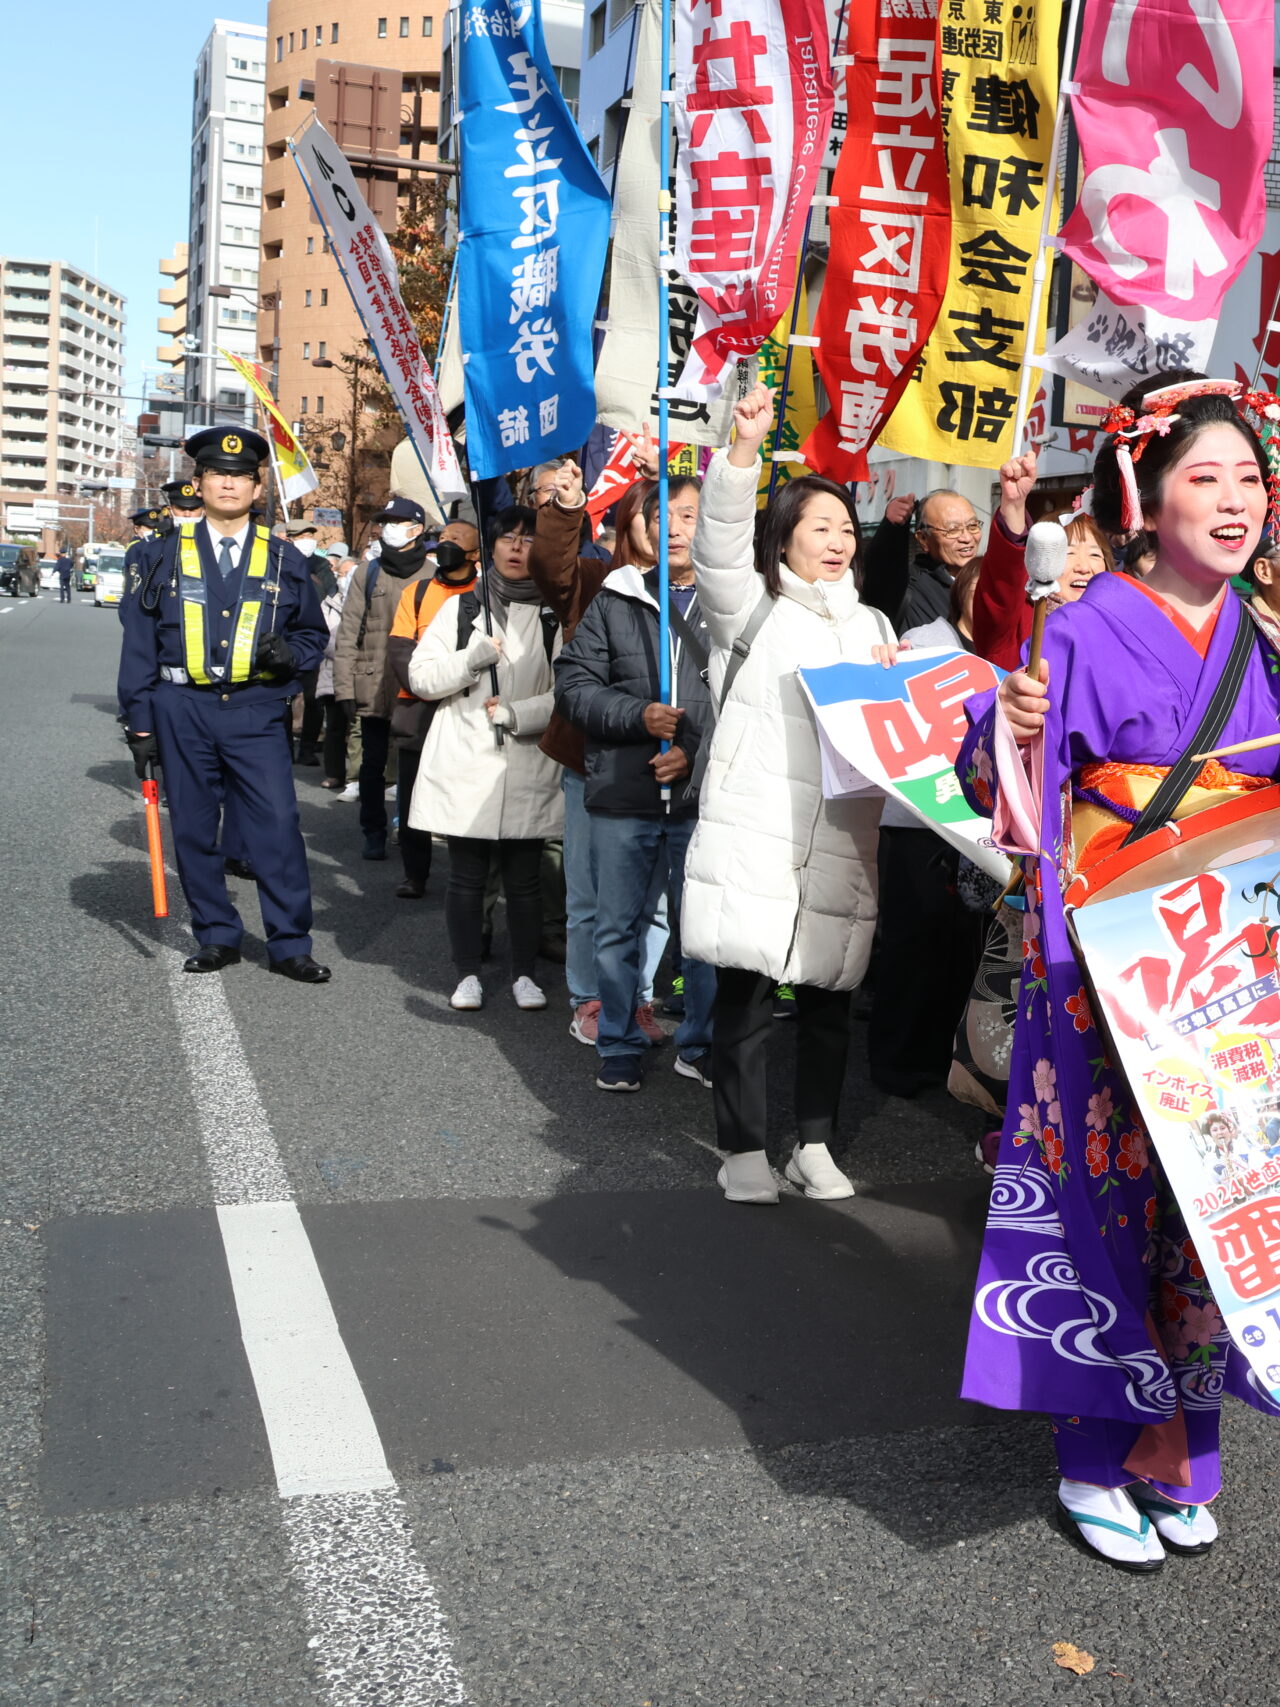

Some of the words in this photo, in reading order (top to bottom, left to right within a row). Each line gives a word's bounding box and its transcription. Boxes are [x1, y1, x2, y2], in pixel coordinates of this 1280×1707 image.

[1165, 981, 1268, 1038] な物価高騰に
[1211, 1040, 1262, 1070] 消費税
[1142, 1069, 1214, 1100] インボイス
[1234, 1059, 1268, 1083] 減税
[1158, 1089, 1190, 1115] 廃止
[1193, 1181, 1244, 1217] 2024
